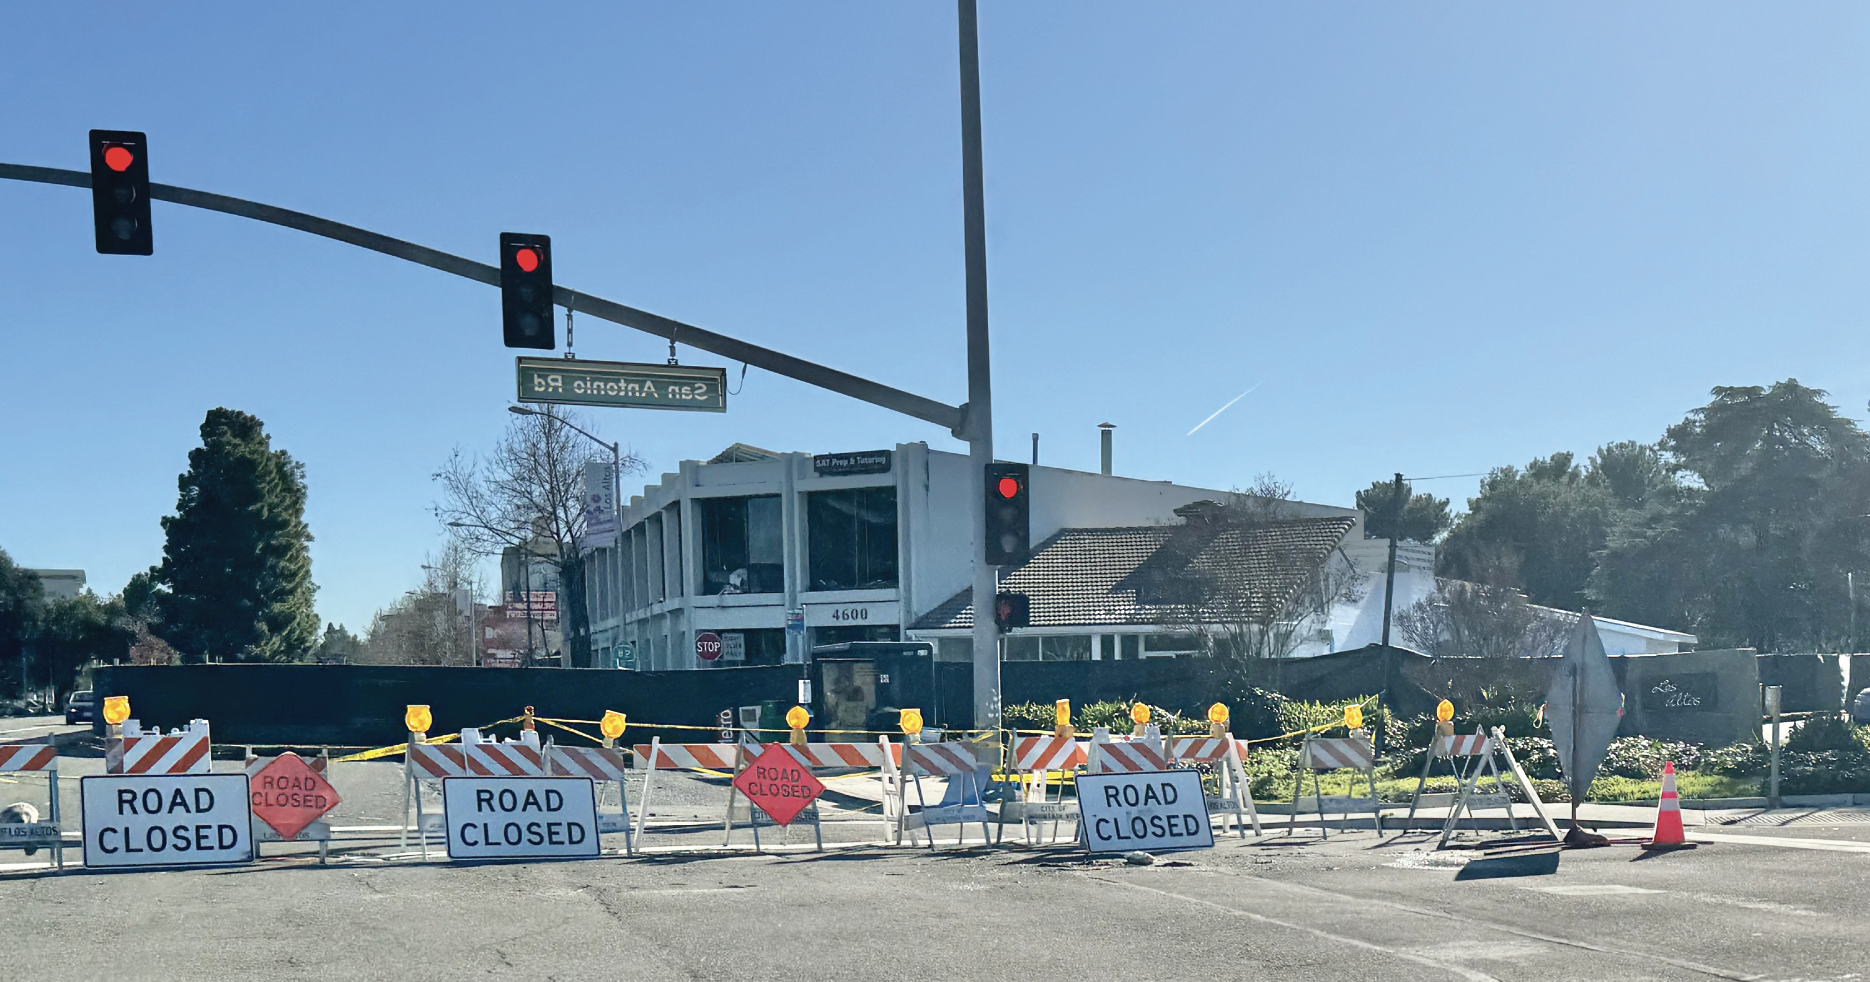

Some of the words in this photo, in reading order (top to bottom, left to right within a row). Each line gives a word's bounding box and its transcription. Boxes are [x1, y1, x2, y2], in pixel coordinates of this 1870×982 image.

[816, 459, 830, 467] SAT
[832, 458, 848, 467] Prep
[856, 456, 886, 464] Tutoring
[602, 466, 611, 490] Altos
[603, 492, 612, 510] Los
[832, 608, 868, 620] 4600
[697, 641, 720, 652] STOP
[1651, 679, 1677, 693] Los
[1665, 692, 1701, 707] Altos
[263, 775, 316, 791] ROAD
[756, 766, 801, 783] ROAD
[748, 782, 811, 799] CLOSED
[1104, 782, 1178, 808] ROAD
[117, 788, 215, 815] ROAD
[251, 791, 327, 809] CLOSED
[476, 788, 564, 812] ROAD
[8, 827, 27, 836] LOS
[30, 826, 59, 836] ALTOS
[460, 822, 586, 847] CLOSED
[1095, 814, 1200, 841] CLOSED
[98, 824, 238, 854] CLOSED
